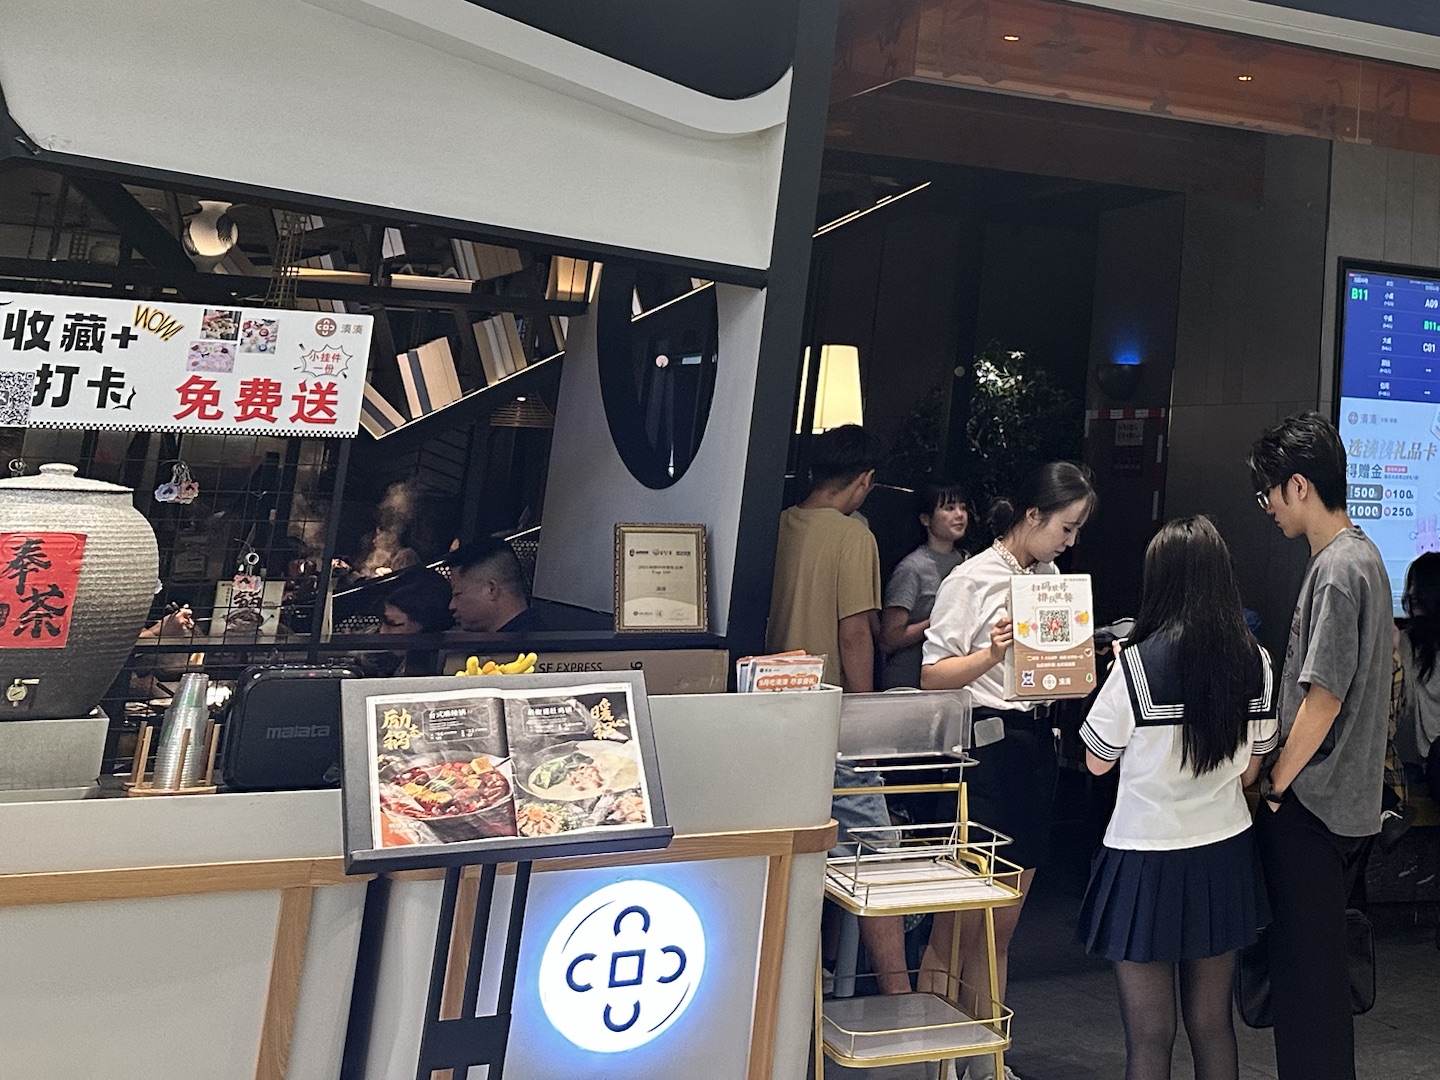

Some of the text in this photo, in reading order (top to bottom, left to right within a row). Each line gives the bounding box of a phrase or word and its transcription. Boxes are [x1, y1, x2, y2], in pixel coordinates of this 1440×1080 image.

[1351, 287, 1369, 301] B11
[1424, 298, 1439, 309] A09
[133, 304, 185, 342] WOW!
[1422, 342, 1436, 353] C01
[308, 352, 342, 363] 小挂件
[313, 365, 335, 375] 一份
[31, 363, 126, 409] 打卡
[173, 374, 339, 425] 免费送
[1, 537, 68, 638] 奉茶
[556, 661, 605, 673] EXPRESS
[265, 724, 331, 740] malata
